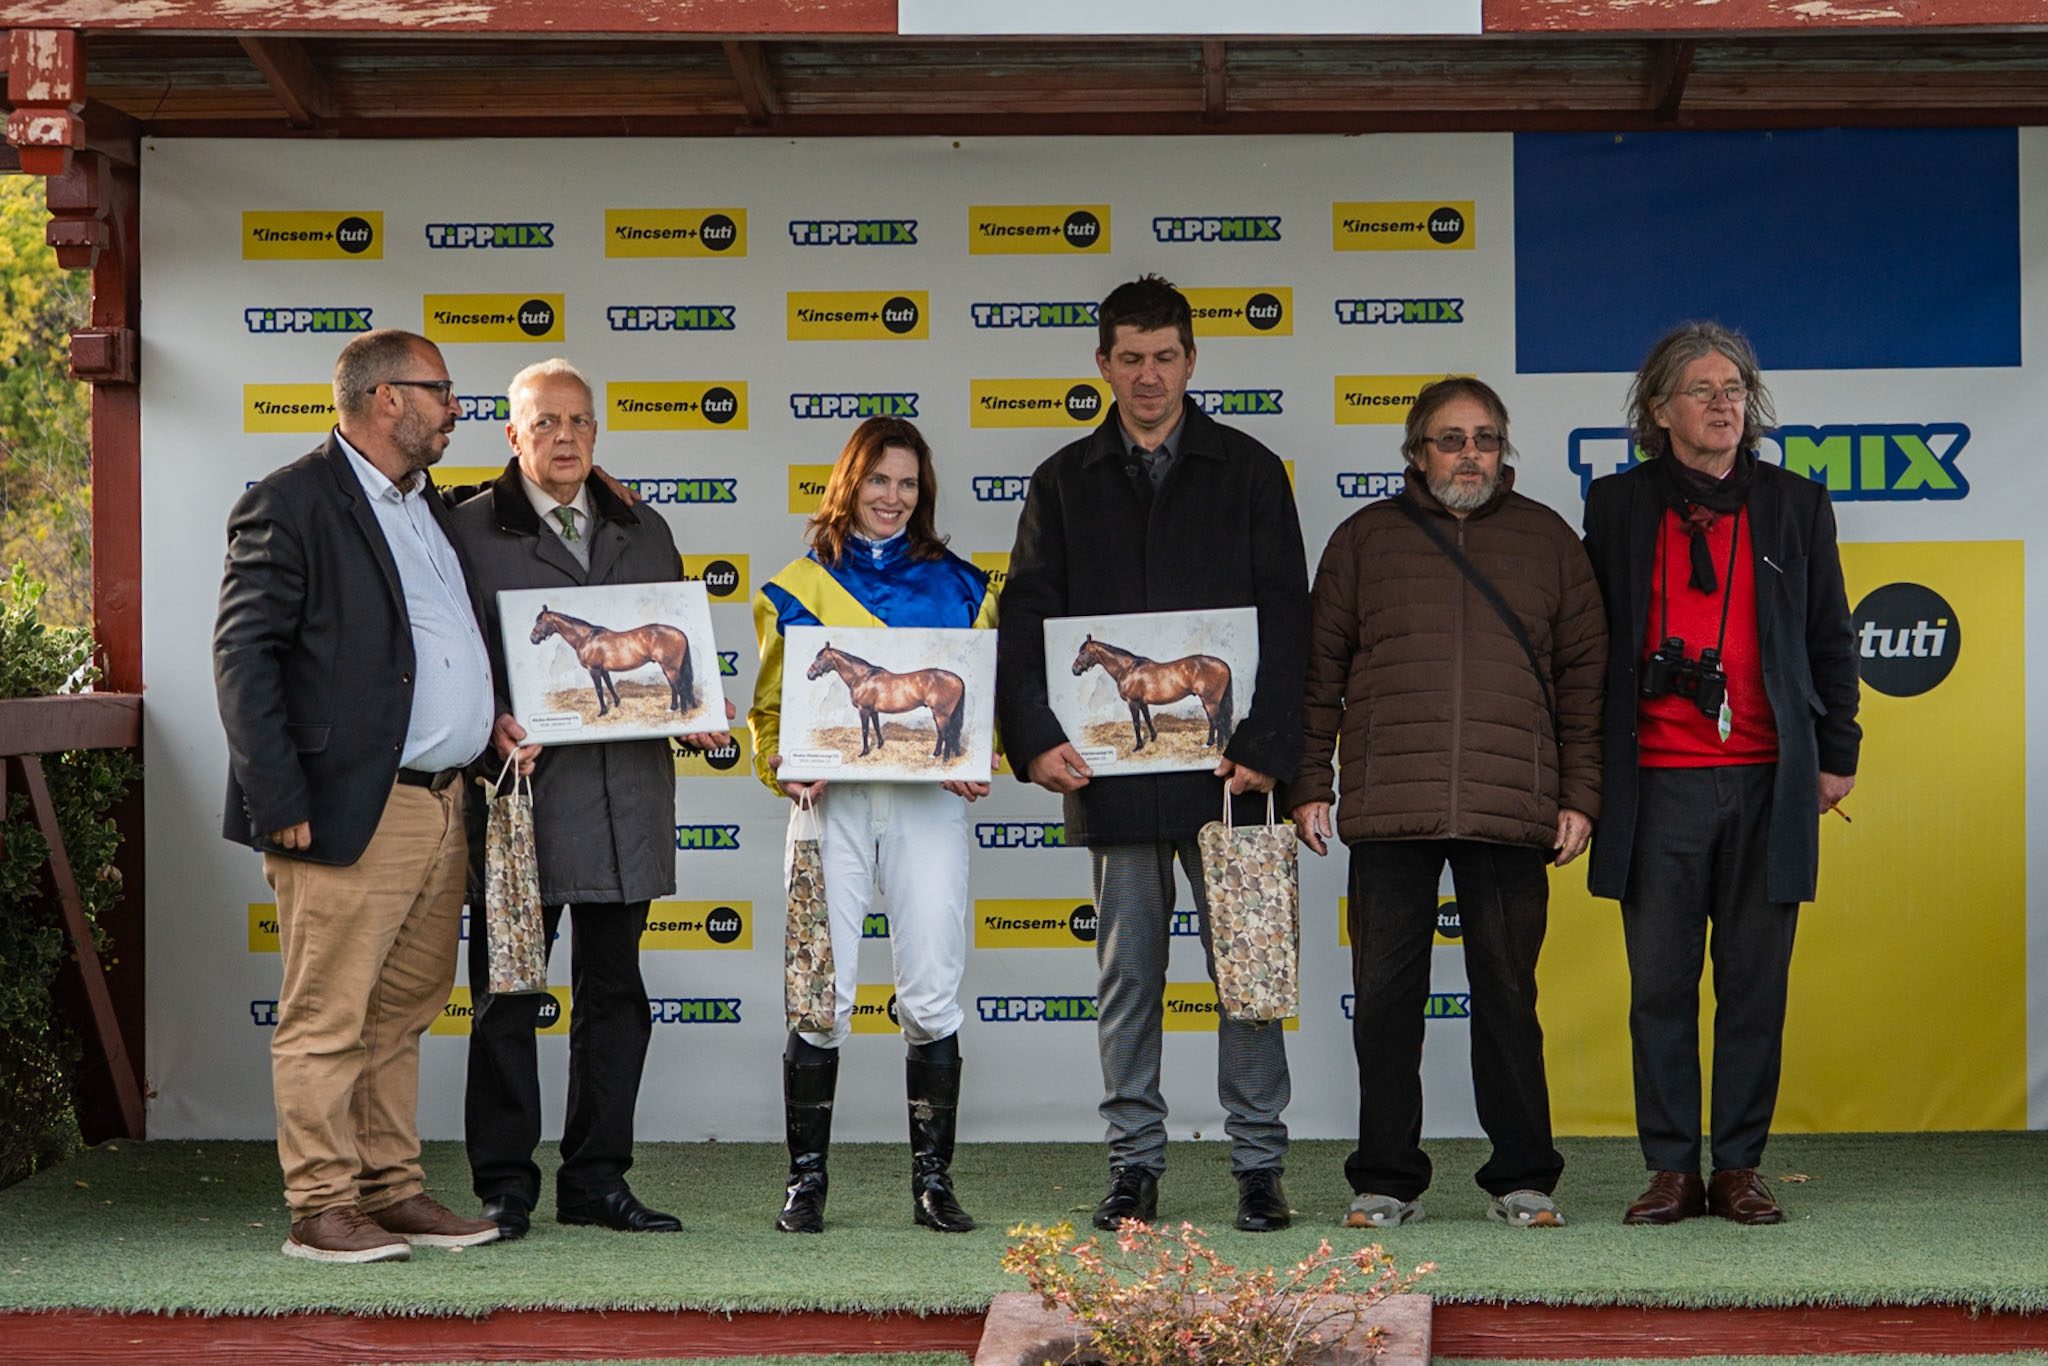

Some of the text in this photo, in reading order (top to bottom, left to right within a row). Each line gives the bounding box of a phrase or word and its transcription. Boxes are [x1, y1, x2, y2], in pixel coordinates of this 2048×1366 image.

[1067, 221, 1097, 235] tuti
[1432, 217, 1462, 231] tuti
[340, 227, 370, 241] tuti
[704, 225, 734, 239] tuti
[522, 310, 552, 324] tuti
[886, 307, 916, 321] tuti
[1190, 304, 1280, 318] csem+ tuti
[705, 397, 735, 411] tuti
[1069, 395, 1099, 409] tuti
[707, 570, 737, 584] tuti
[1859, 618, 1948, 658] tuti
[709, 917, 739, 931] tuti
